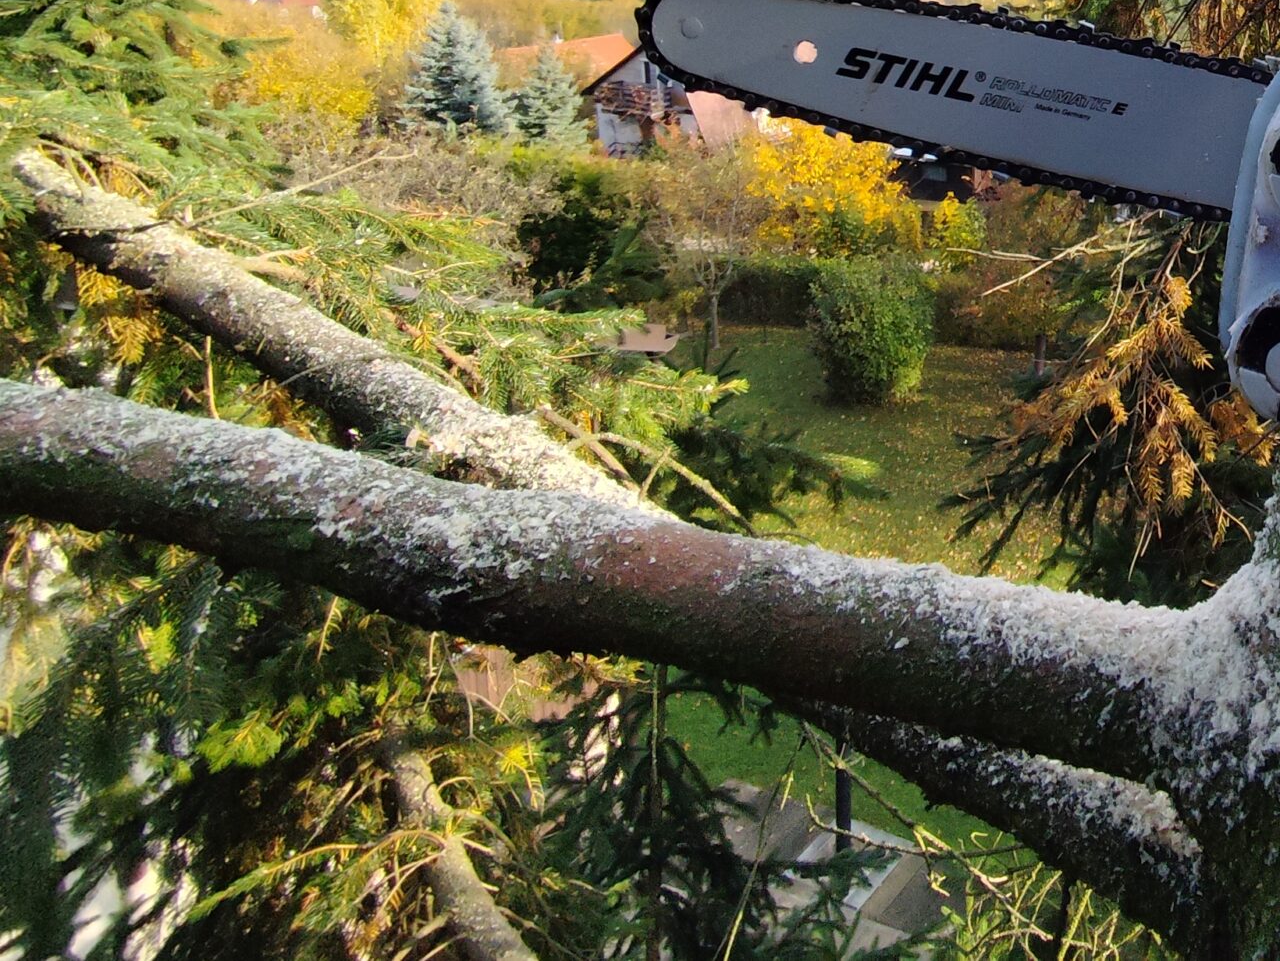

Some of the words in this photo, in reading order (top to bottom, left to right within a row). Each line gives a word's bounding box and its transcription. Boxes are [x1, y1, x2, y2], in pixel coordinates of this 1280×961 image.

[836, 47, 975, 103] STIHL
[1036, 103, 1053, 113] Made
[1062, 108, 1091, 121] Germany
[1111, 102, 1128, 116] E
